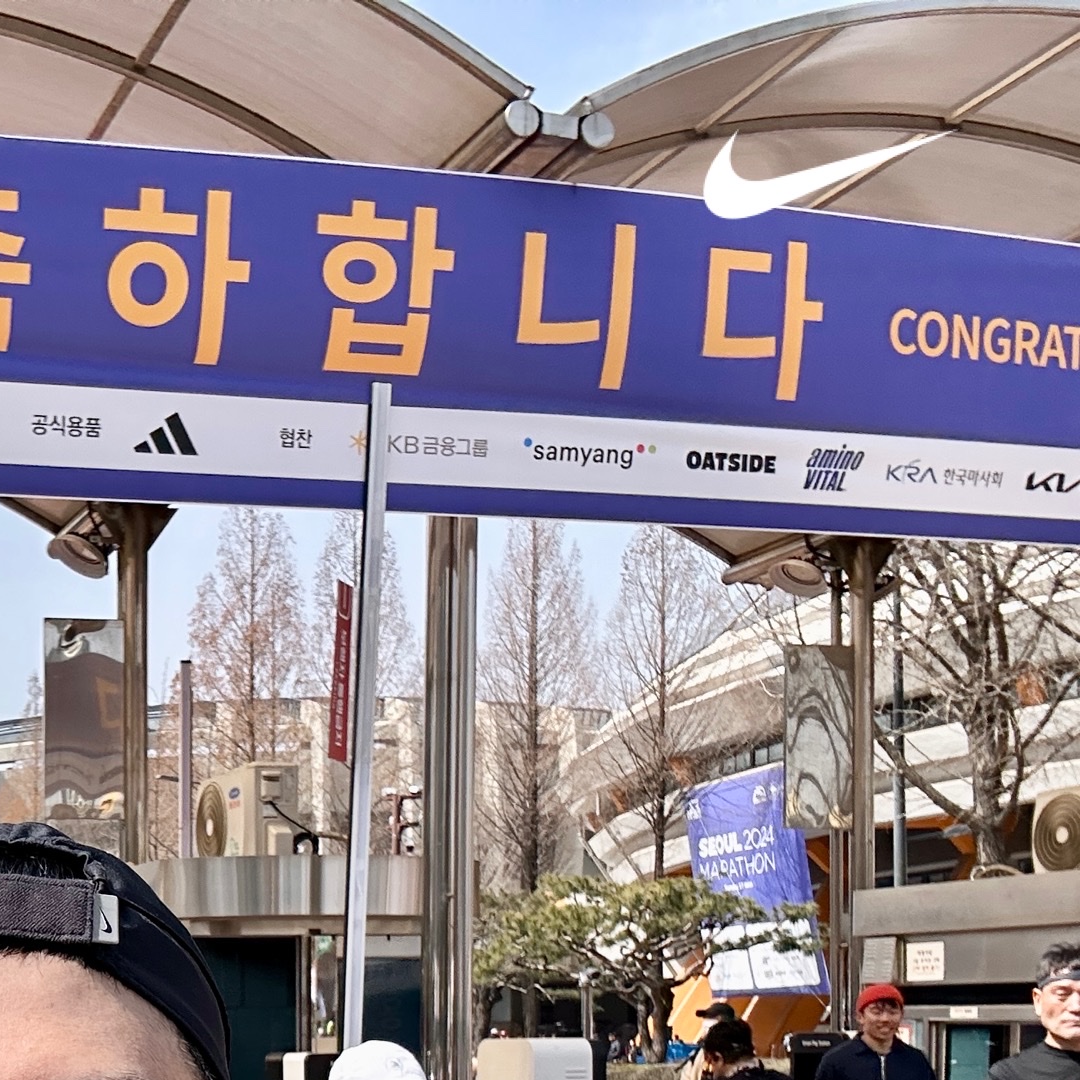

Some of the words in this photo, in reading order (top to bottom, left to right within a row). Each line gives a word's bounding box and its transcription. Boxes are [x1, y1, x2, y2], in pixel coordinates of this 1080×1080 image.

[31, 414, 102, 438] 공식용품
[280, 428, 313, 449] 협찬
[533, 443, 634, 469] samyang
[686, 450, 777, 474] OATSIDE
[806, 444, 865, 471] amino
[803, 469, 847, 492] VITAL
[886, 459, 938, 484] KRA
[944, 469, 1004, 488] 한국마사회
[699, 831, 742, 858] SEOUL
[743, 825, 774, 851] 2024
[699, 850, 776, 880] MARATHON
